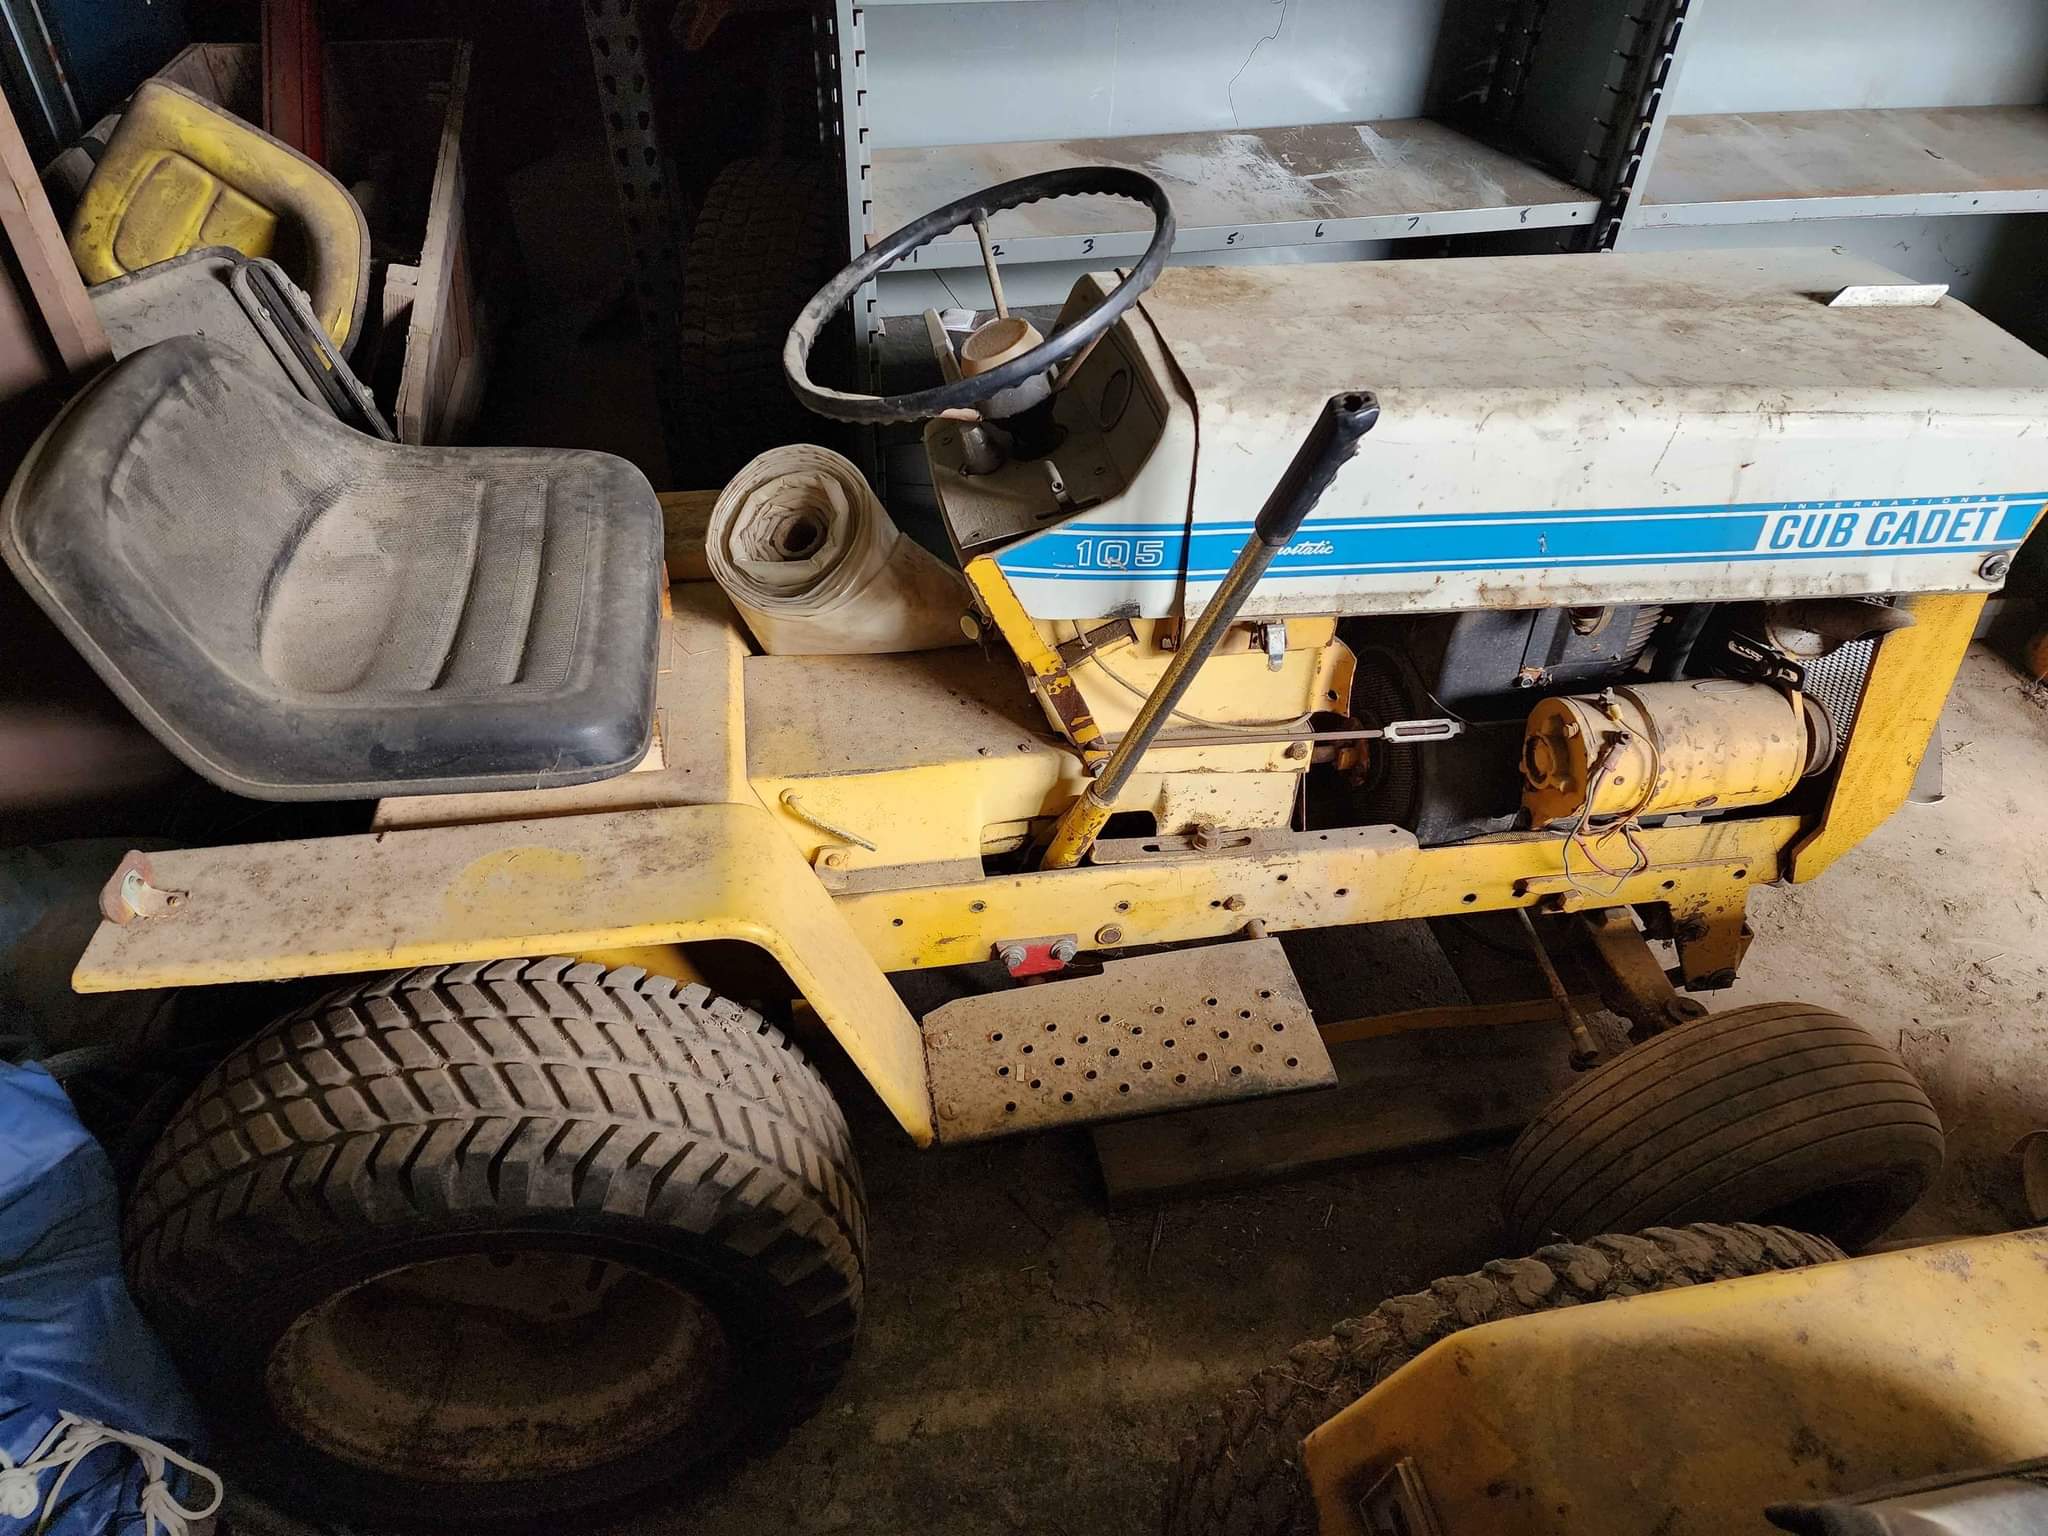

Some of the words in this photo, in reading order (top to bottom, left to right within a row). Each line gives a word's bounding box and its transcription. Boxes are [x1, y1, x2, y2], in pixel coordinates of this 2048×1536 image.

[991, 244, 1005, 257] 2
[1082, 238, 1095, 254] 3
[1225, 232, 1239, 245] 5
[1314, 223, 1324, 238] 6
[1407, 216, 1420, 230] 7
[1519, 207, 1532, 224] 8
[1769, 513, 1860, 550] CUB
[1865, 506, 1999, 546] CADET
[1076, 539, 1164, 567] 105
